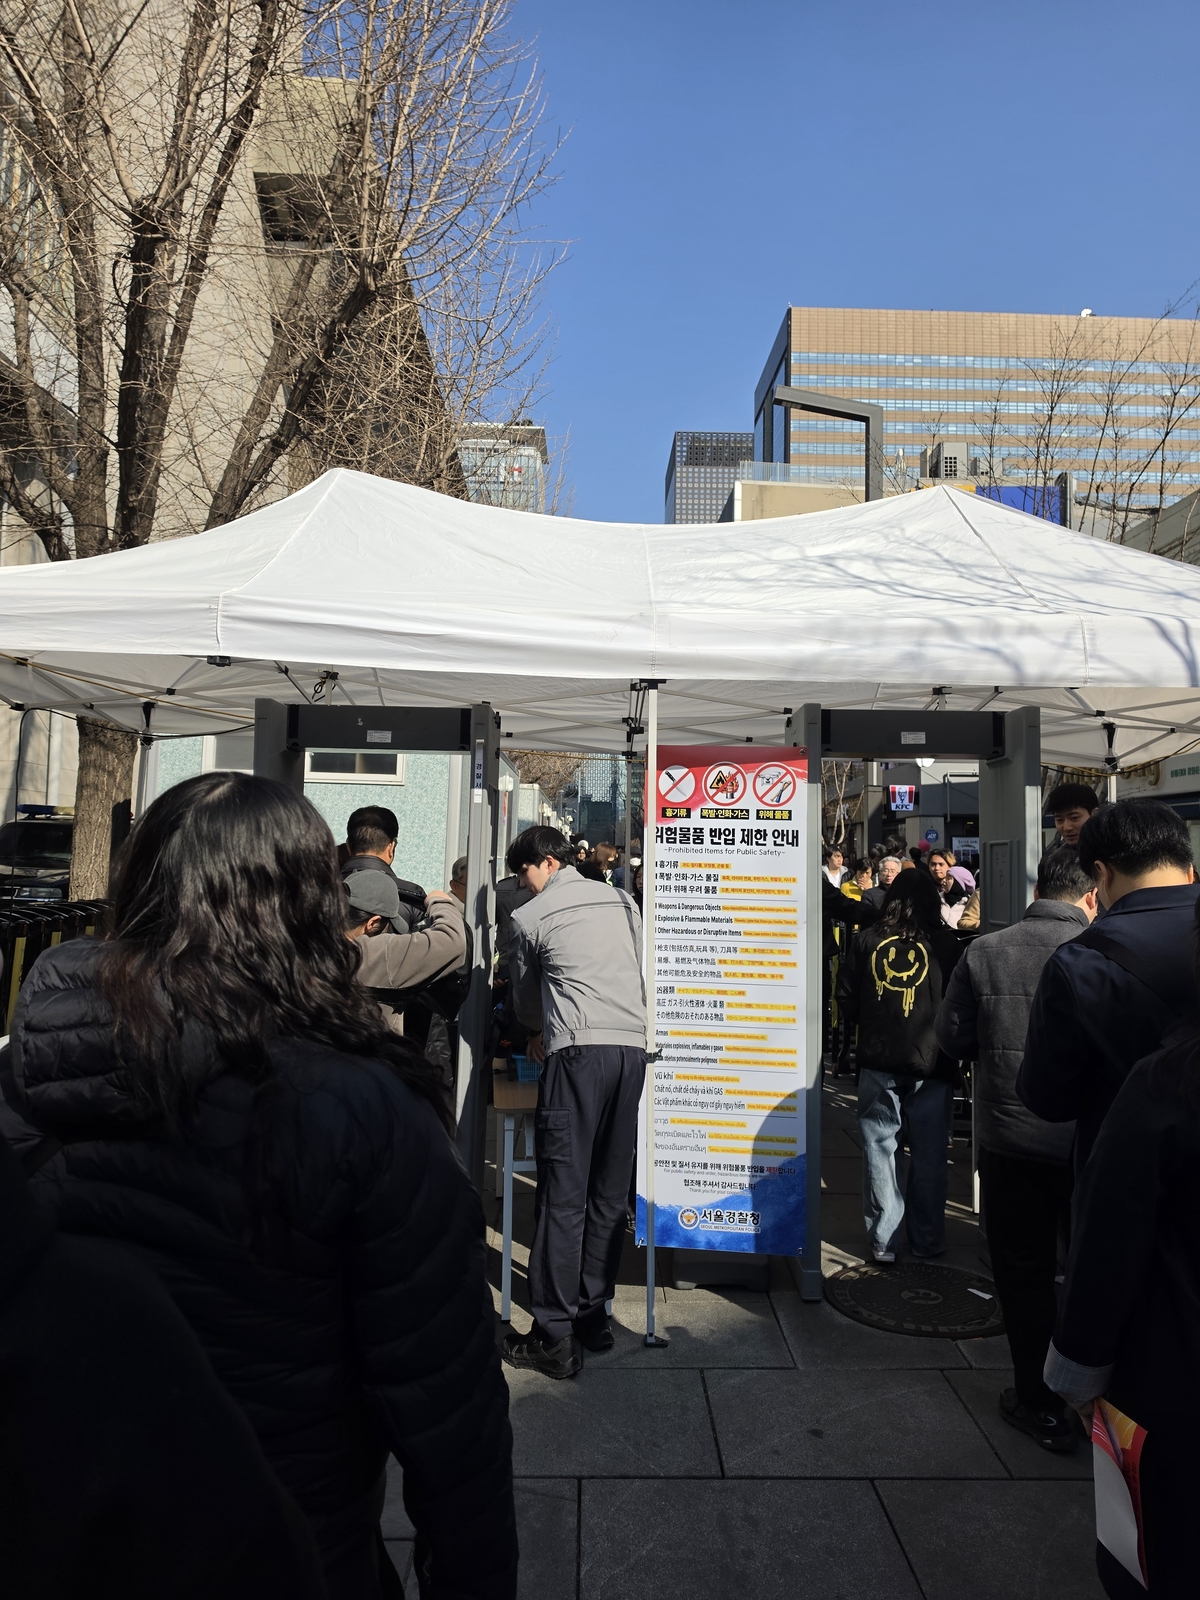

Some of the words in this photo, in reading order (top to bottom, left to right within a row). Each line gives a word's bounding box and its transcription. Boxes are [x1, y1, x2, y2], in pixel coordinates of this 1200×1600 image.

[665, 808, 687, 817] 흉기류
[759, 810, 774, 819] 위해
[775, 811, 789, 819] 물품
[709, 828, 735, 846] 반입
[740, 828, 768, 846] 제한
[772, 829, 799, 847] 안내
[659, 860, 679, 869] 흉기류
[659, 873, 704, 881] 폭발·인화·가스
[706, 874, 719, 882] 물질
[659, 885, 671, 893] 기타
[673, 885, 687, 893] 위해
[689, 886, 702, 894] 우려
[704, 886, 717, 894] 물품
[658, 903, 677, 911] Weapons
[682, 903, 704, 911] Dangerous
[705, 904, 721, 912] Objects
[658, 915, 680, 923] Explosive
[703, 928, 727, 937] Disruptive
[673, 1042, 691, 1051] explosivos,
[664, 1055, 676, 1063] objetos
[677, 1055, 700, 1063] potencialmente
[701, 1056, 718, 1065] peligrosos
[655, 1071, 662, 1079] Vũ
[664, 1071, 673, 1079] khí
[654, 1084, 665, 1093] Chất
[673, 1085, 682, 1093] chất
[689, 1085, 700, 1096] cháy
[700, 1086, 706, 1094] và
[654, 1097, 662, 1106] Các
[682, 1098, 692, 1107] khác
[693, 1099, 698, 1107] có
[699, 1101, 709, 1109] nguy
[723, 1102, 734, 1111] nguy
[691, 1162, 708, 1170] 유지를
[710, 1163, 721, 1171] 위해
[723, 1164, 746, 1172] 위험물품
[747, 1165, 764, 1174] 반입을
[684, 1179, 701, 1187] 협조해
[702, 1180, 720, 1188] 주셔서
[702, 1210, 760, 1225] 서울경찰청
